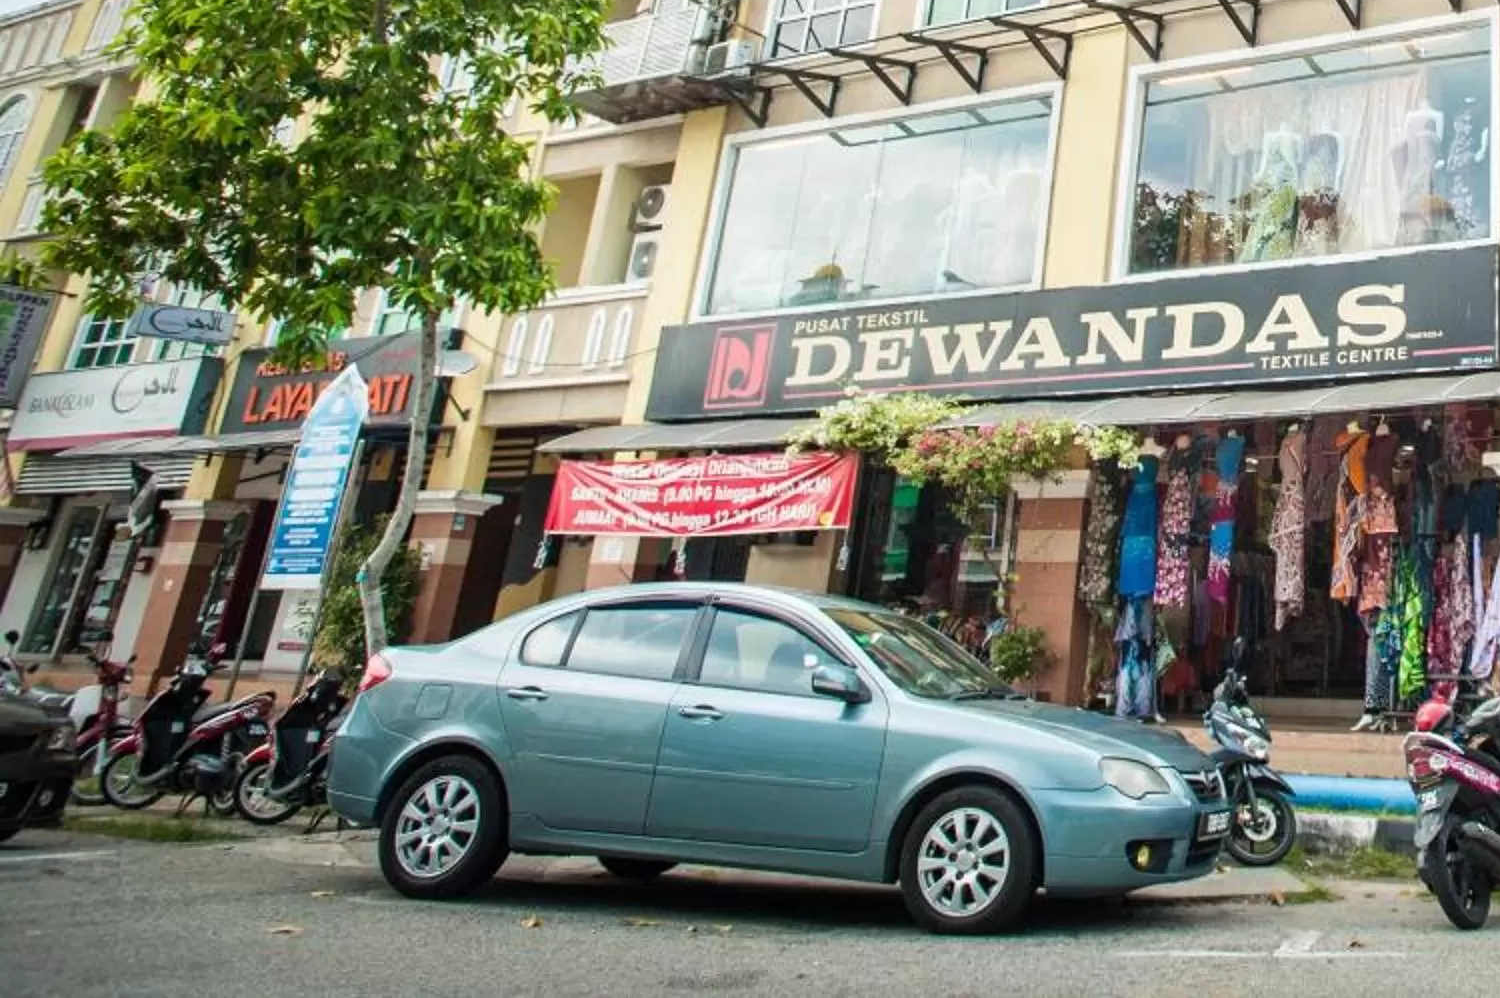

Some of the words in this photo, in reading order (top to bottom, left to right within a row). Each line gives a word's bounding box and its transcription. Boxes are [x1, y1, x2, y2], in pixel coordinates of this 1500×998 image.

[785, 284, 1407, 387] DEWANDAS
[794, 316, 850, 335] PUSAT
[857, 309, 929, 330] TEKSTIL
[1260, 352, 1329, 370] TEXTILE
[1336, 345, 1409, 365] CENTRE
[242, 373, 413, 424] LAYAATI
